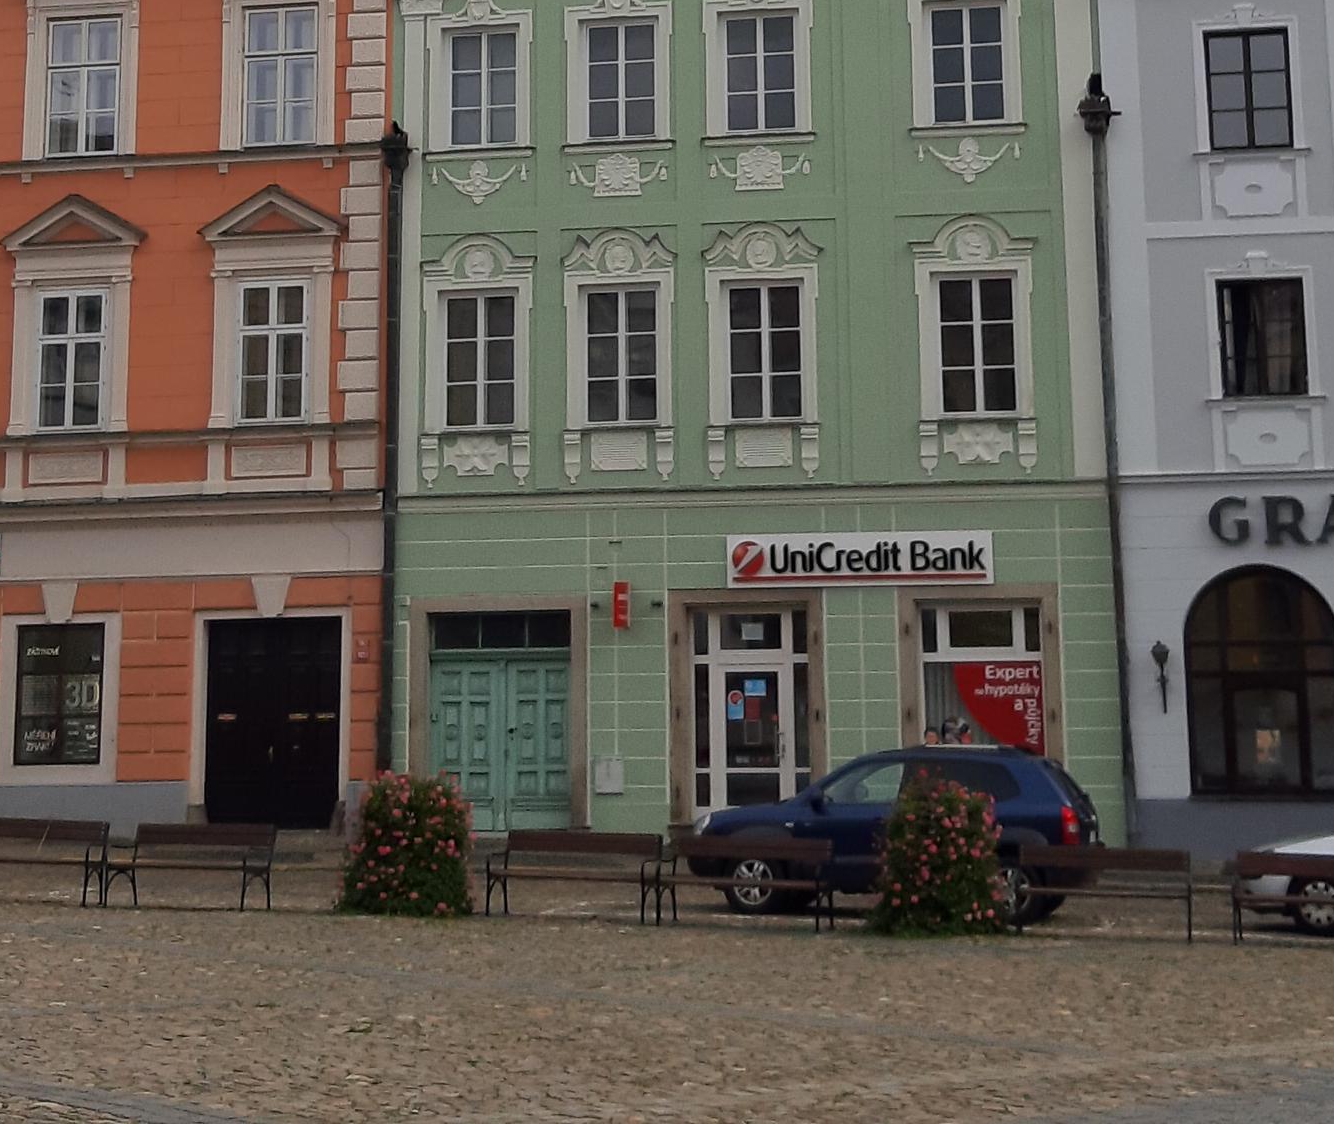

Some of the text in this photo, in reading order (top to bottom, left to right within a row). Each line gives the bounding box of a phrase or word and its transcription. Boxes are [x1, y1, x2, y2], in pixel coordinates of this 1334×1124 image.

[769, 539, 987, 575] UniCredit Bank
[984, 664, 1041, 681] Expert
[65, 680, 100, 708] 3D
[984, 683, 1040, 697] hypotéky
[1013, 698, 1024, 711] a
